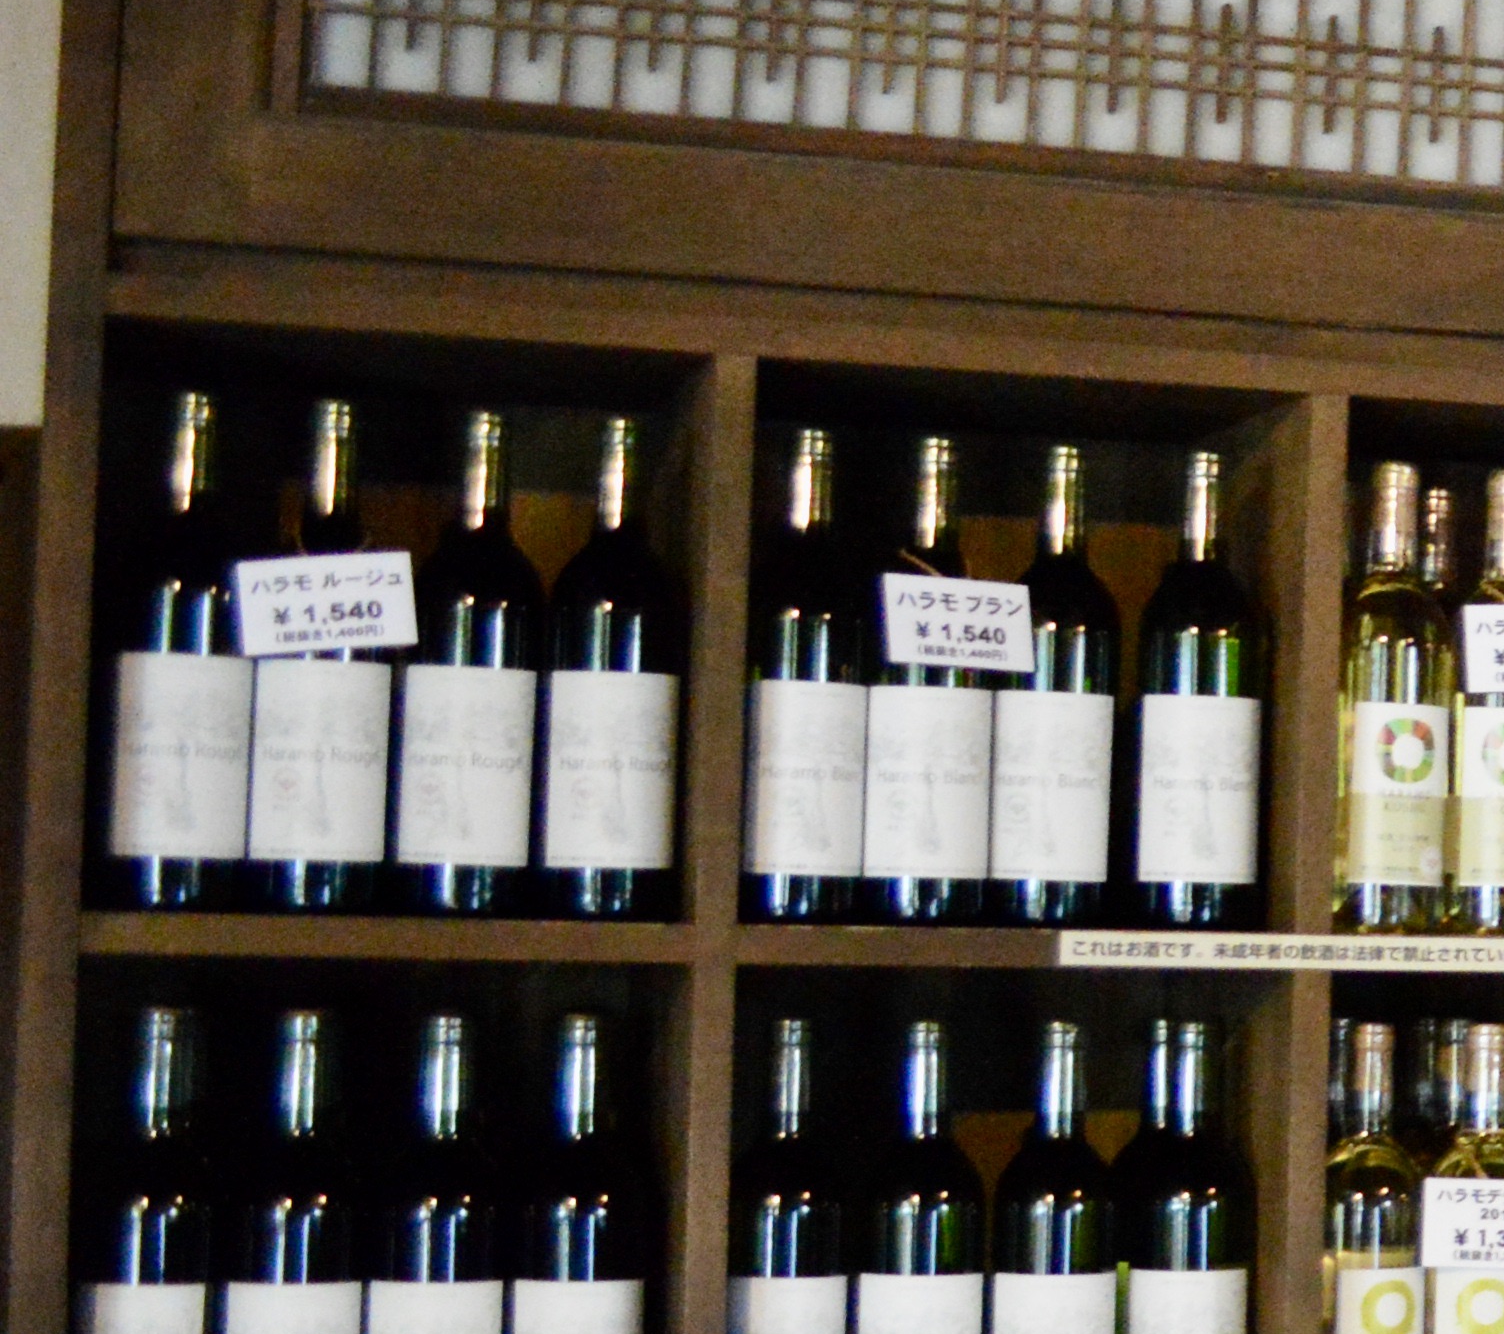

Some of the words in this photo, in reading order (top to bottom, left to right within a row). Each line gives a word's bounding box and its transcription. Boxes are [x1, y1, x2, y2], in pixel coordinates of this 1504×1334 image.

[252, 573, 312, 593] ハラモ
[324, 570, 403, 588] ルージュ
[304, 601, 382, 624] 1,540
[897, 591, 965, 613] ハラモ
[967, 595, 1023, 616] ブラン
[941, 623, 1006, 645] 1,540
